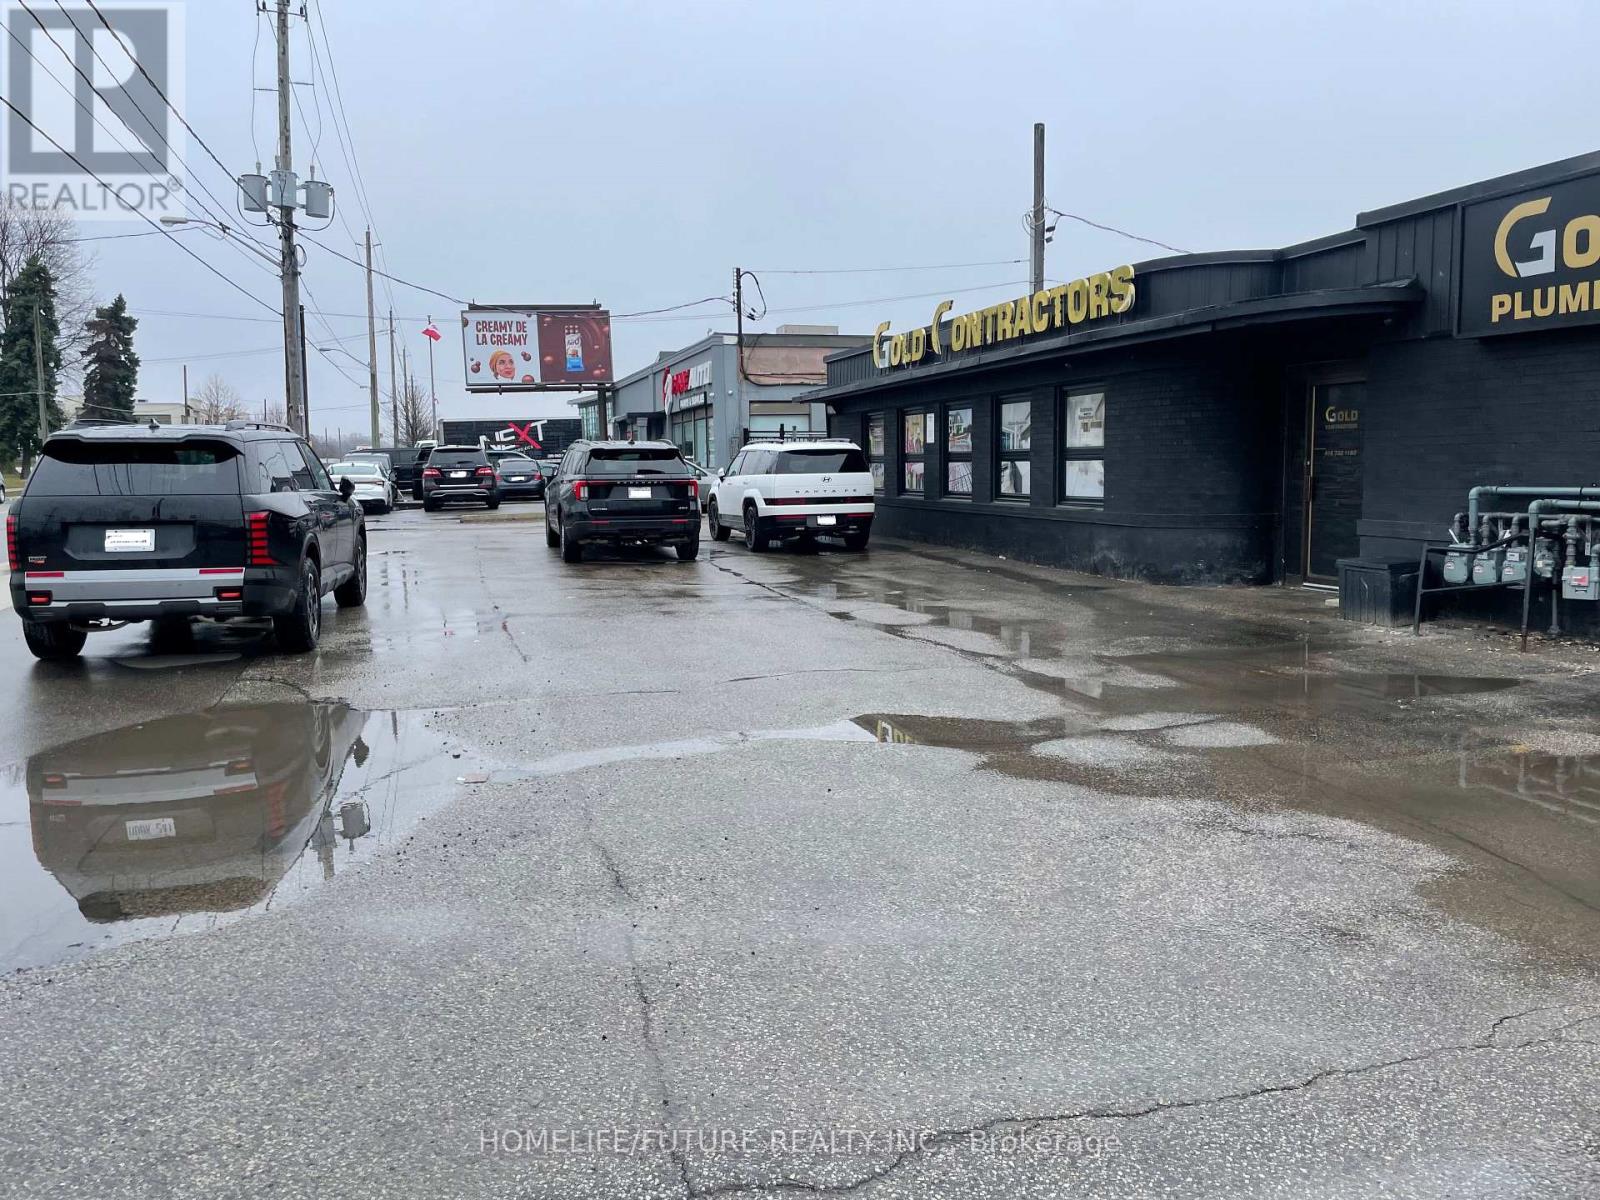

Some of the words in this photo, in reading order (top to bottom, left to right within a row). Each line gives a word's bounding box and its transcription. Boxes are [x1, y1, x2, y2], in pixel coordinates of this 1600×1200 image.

[1491, 280, 1600, 323] PLUM
[873, 320, 926, 369] GOLD
[932, 264, 1136, 355] CONTRACTORS
[475, 320, 513, 334] CREAMY
[516, 320, 528, 333] DE
[476, 333, 488, 346] LA
[490, 333, 528, 346] CREAMY
[1325, 406, 1359, 422] GOLD
